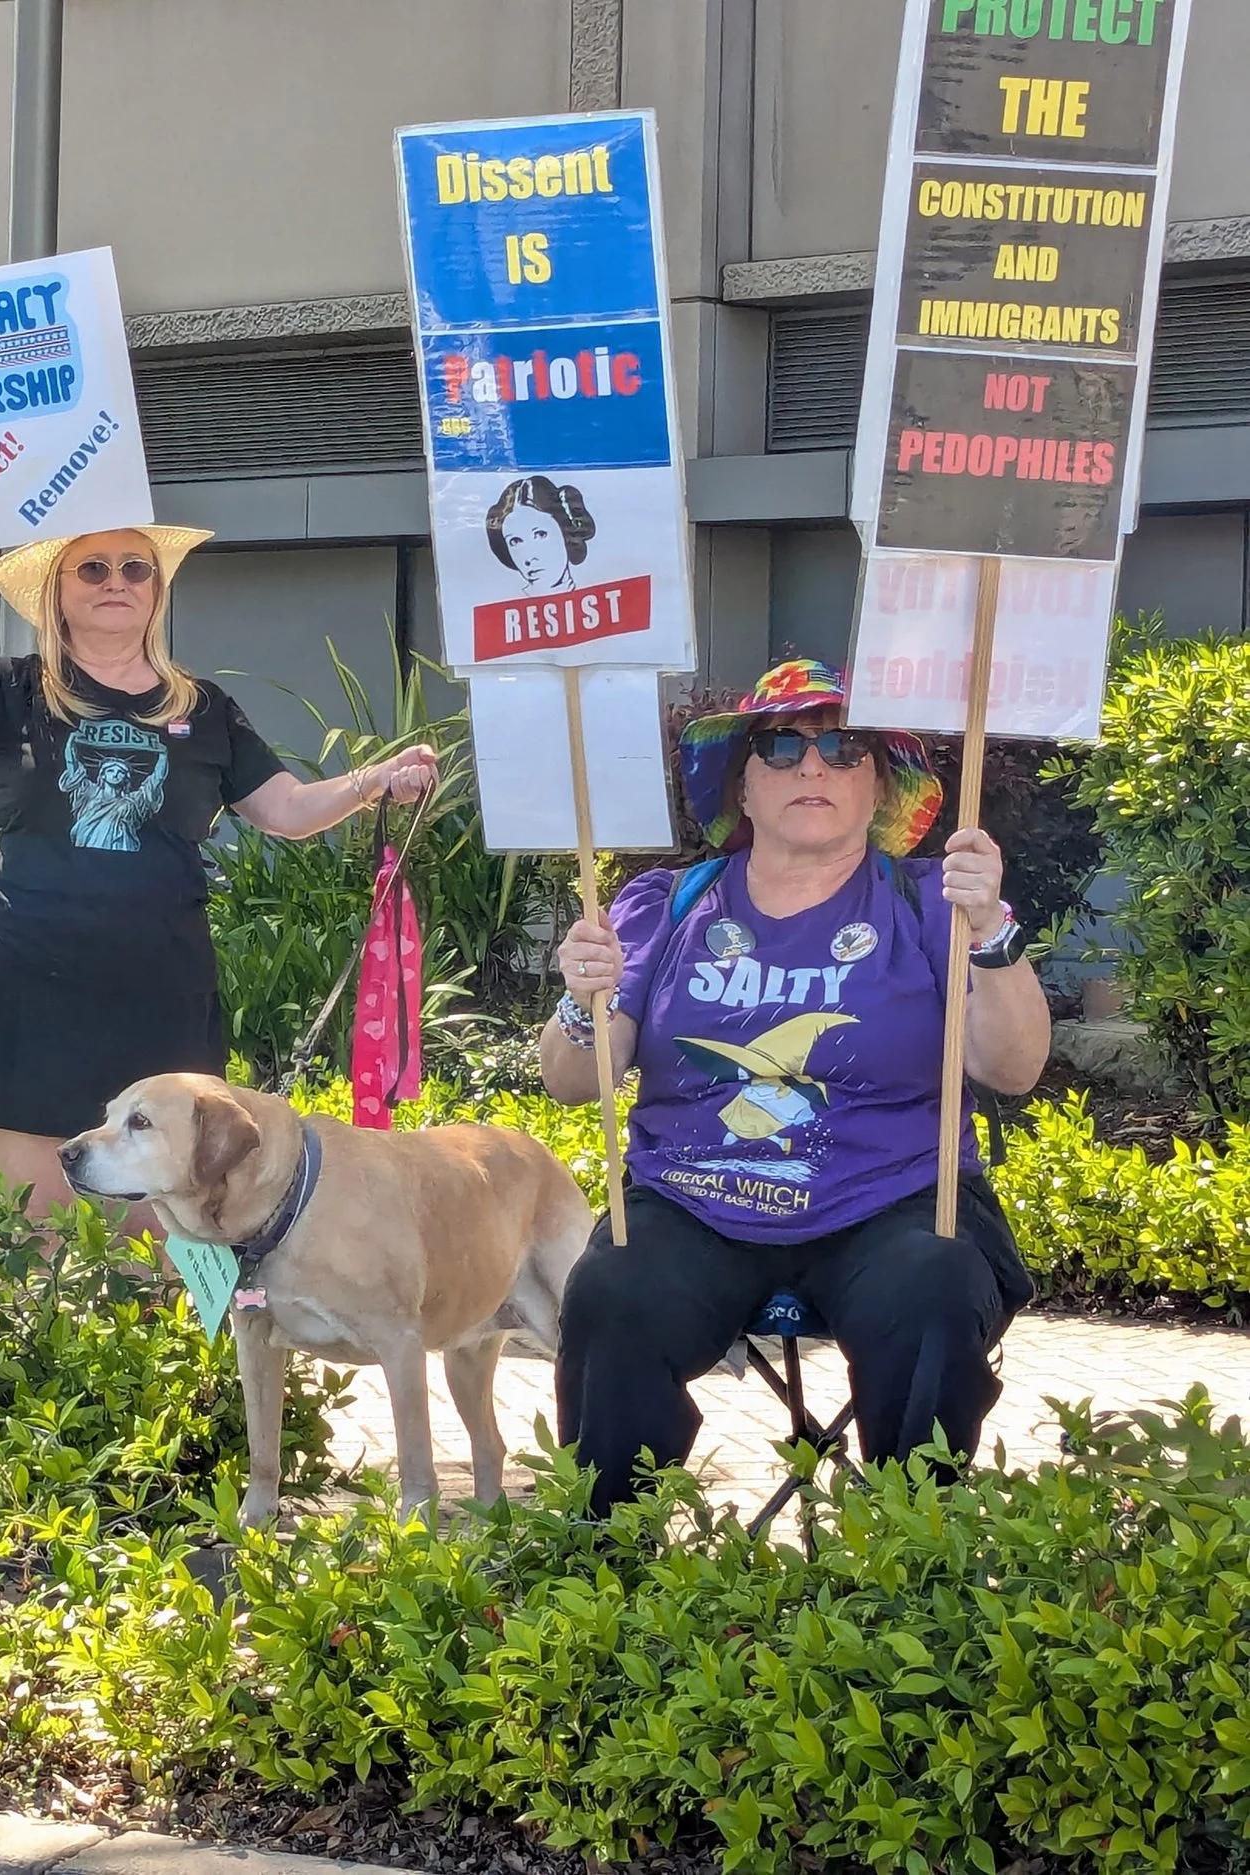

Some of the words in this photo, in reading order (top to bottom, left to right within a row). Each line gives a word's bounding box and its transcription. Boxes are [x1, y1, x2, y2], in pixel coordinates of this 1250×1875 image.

[942, 0, 1163, 46] PROTECT
[999, 76, 1090, 138] THE
[436, 145, 613, 205] Dissent
[917, 180, 1146, 228] CONSTITUTION
[505, 233, 552, 285] IS
[993, 244, 1059, 282] AND
[918, 299, 1121, 345] IMMIGRANTS
[443, 346, 643, 406] Patriotic
[983, 373, 1050, 413] NOT
[18, 410, 120, 527] Remove!
[897, 430, 1115, 486] PEDOPHILES
[504, 590, 621, 643] RESIST
[84, 724, 160, 750] RESIST
[688, 956, 856, 1008] SALTY
[736, 1176, 810, 1210] WITCH
